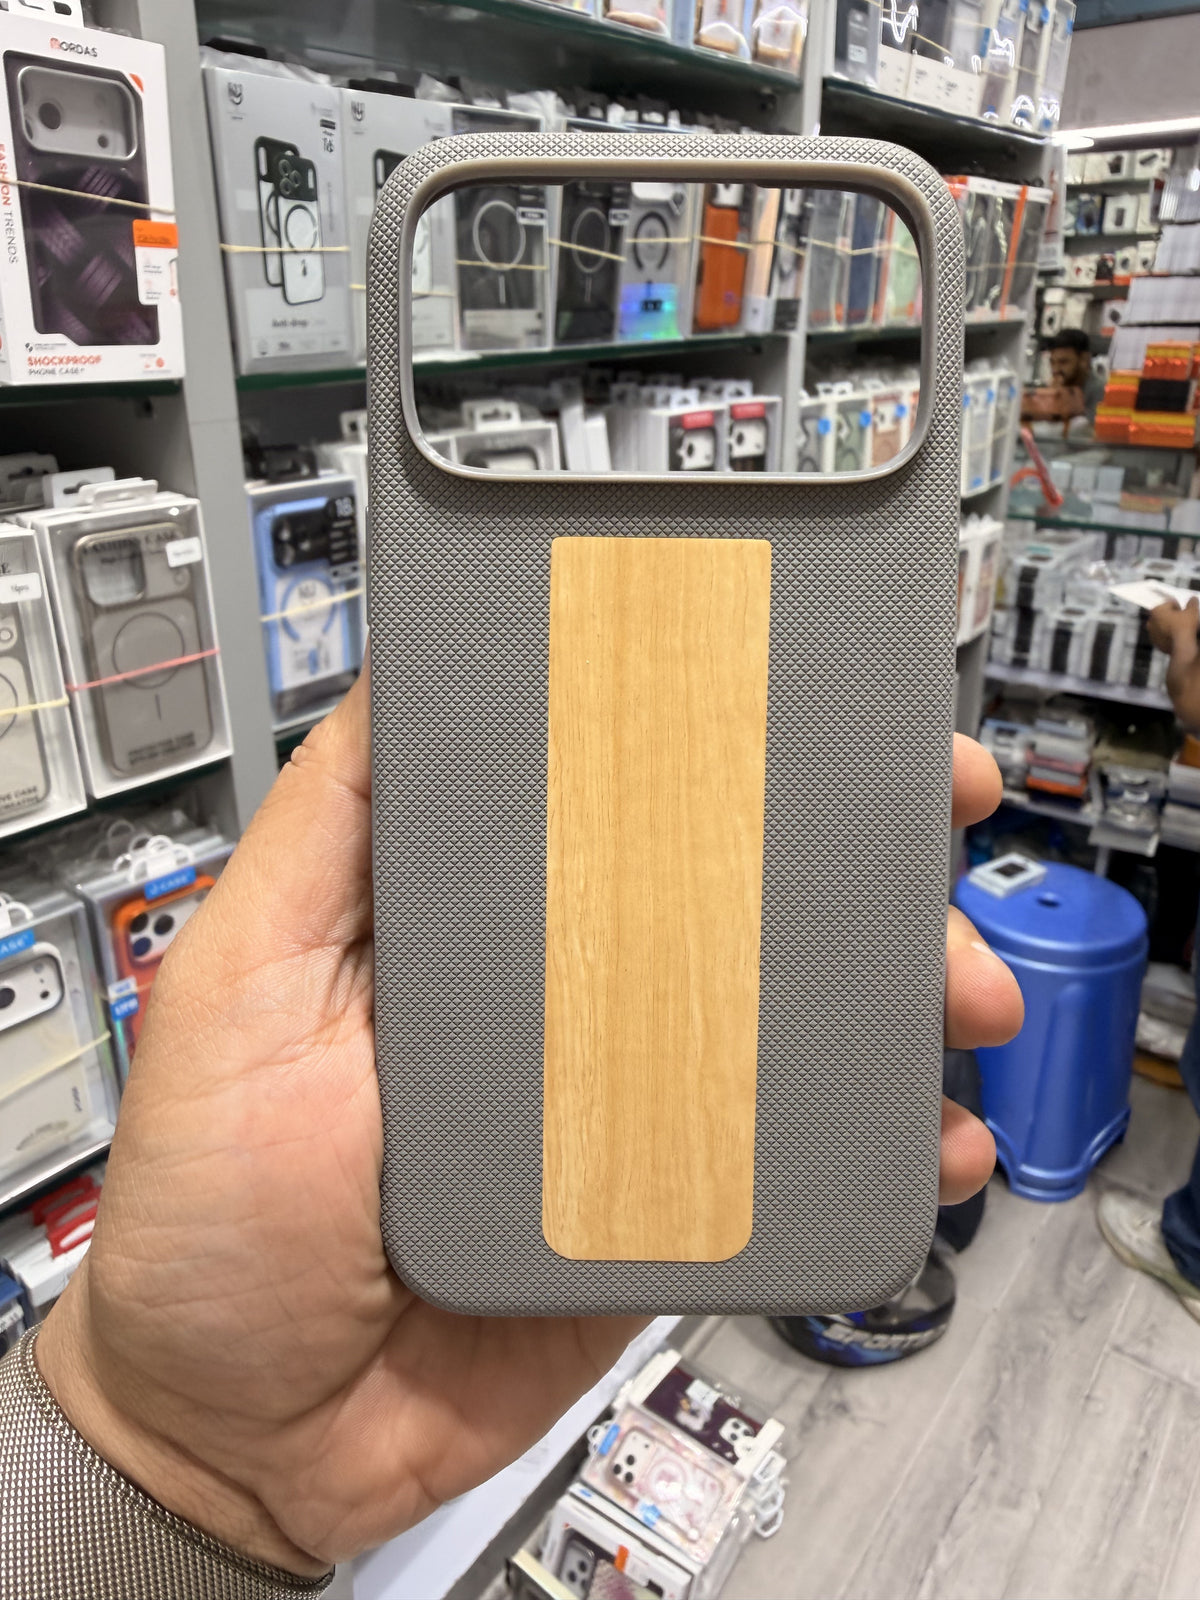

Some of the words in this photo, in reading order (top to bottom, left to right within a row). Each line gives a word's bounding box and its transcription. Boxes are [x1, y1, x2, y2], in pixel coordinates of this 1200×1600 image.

[0, 143, 12, 206] FASHON
[4, 211, 19, 265] TRENDS
[27, 355, 102, 367] SHOCKPROOF
